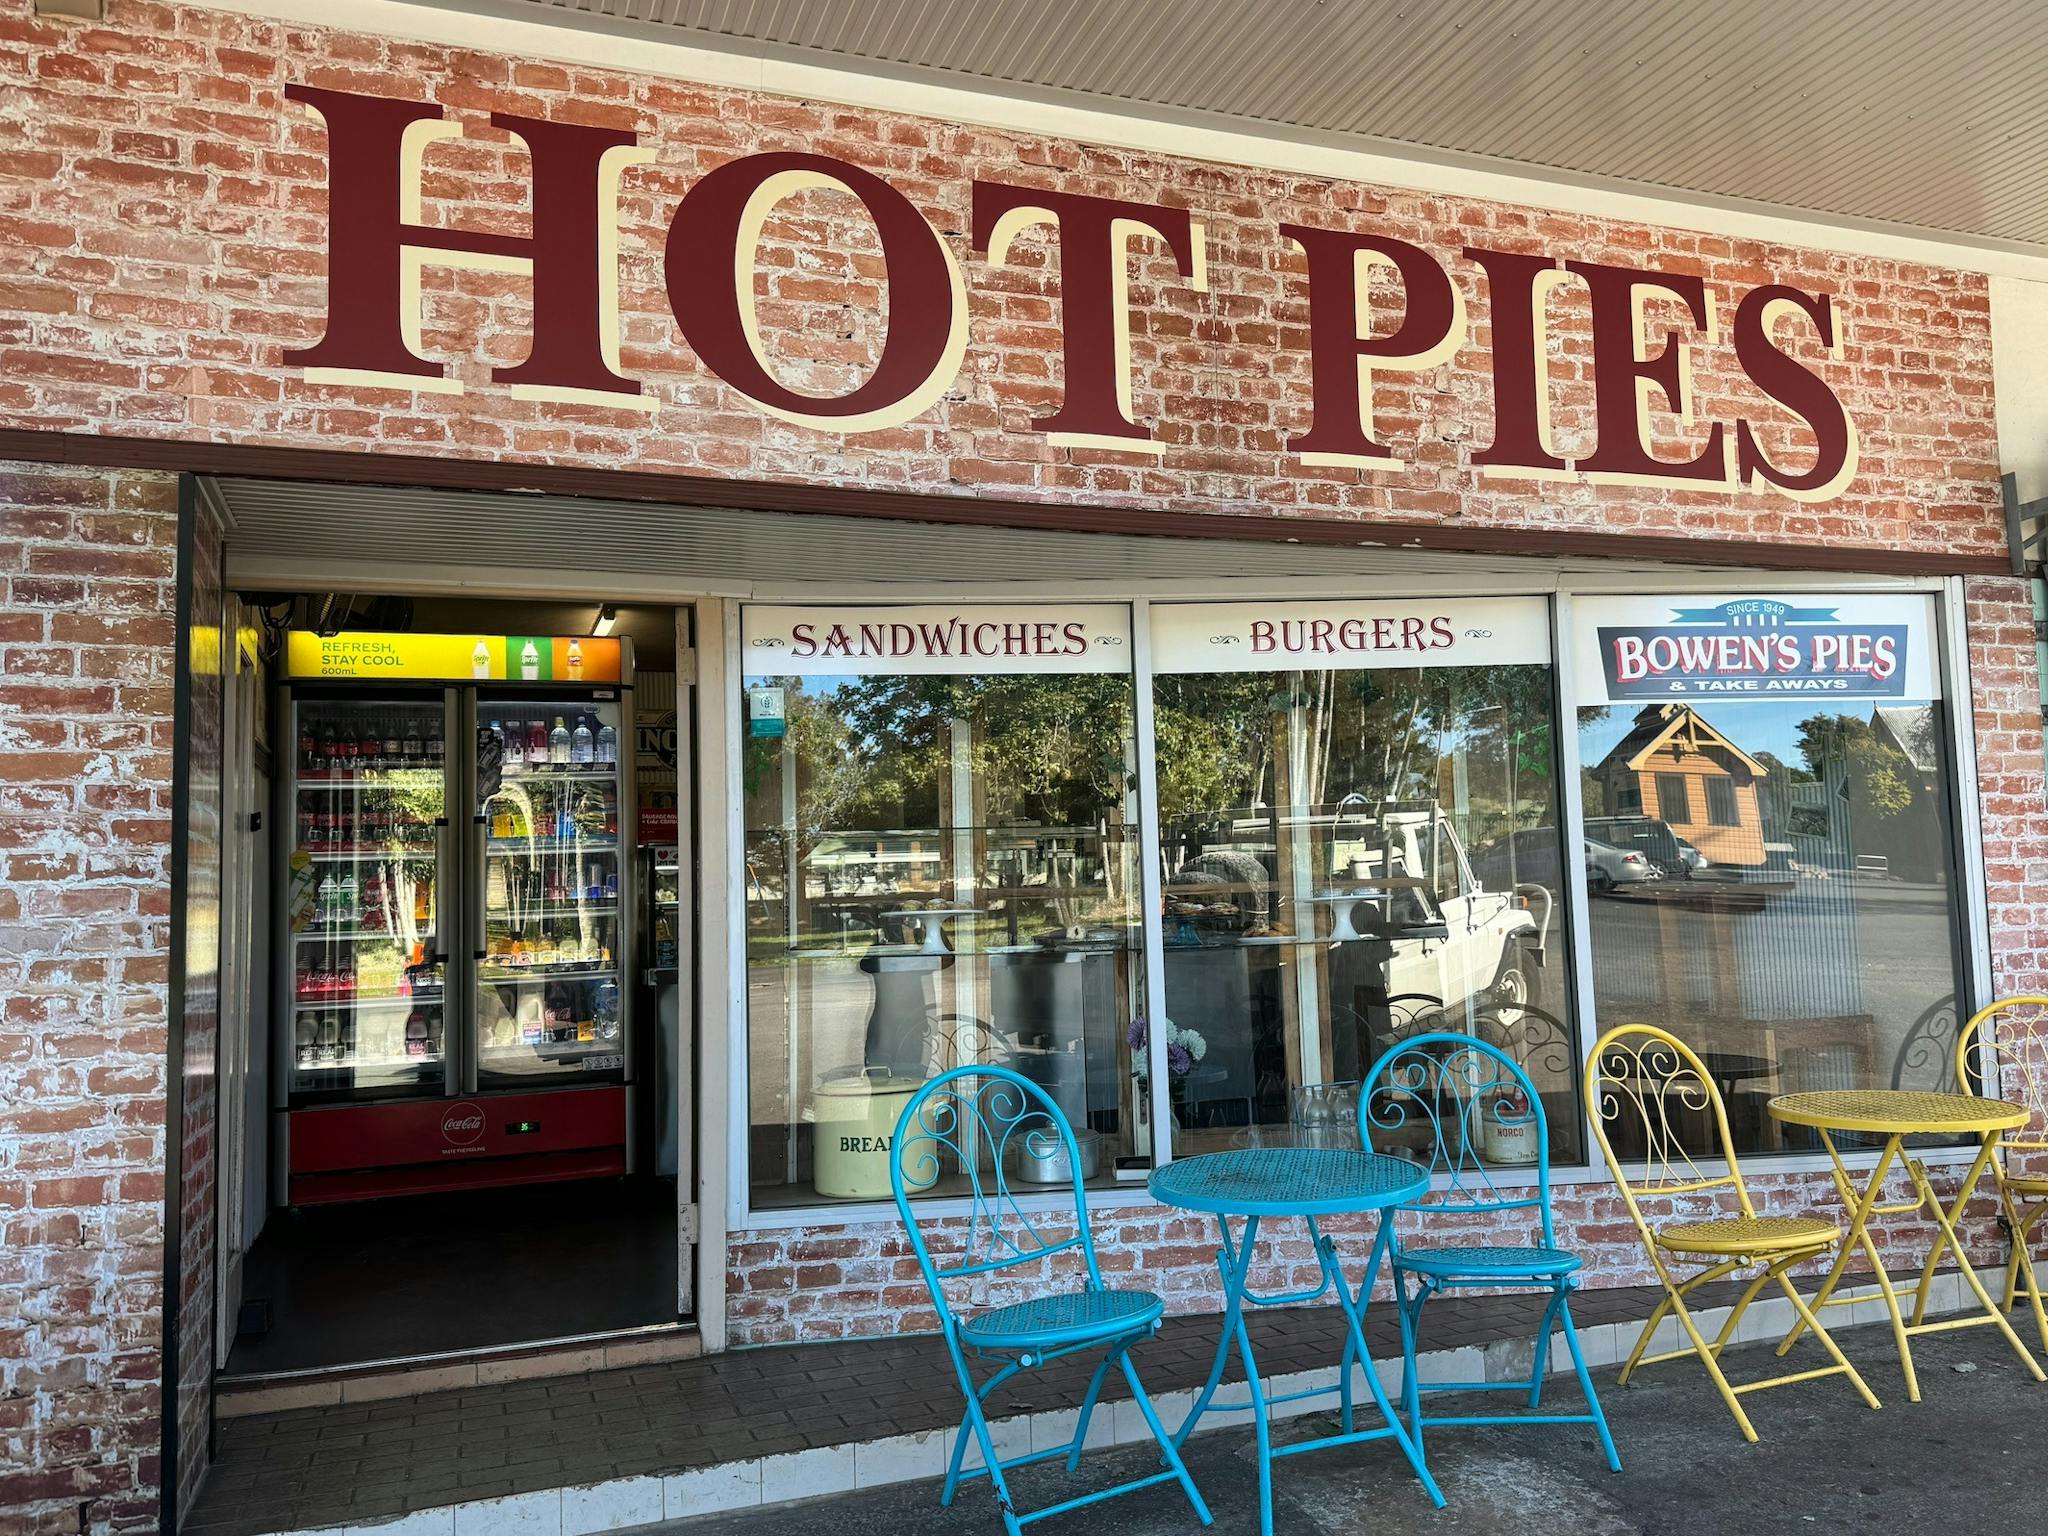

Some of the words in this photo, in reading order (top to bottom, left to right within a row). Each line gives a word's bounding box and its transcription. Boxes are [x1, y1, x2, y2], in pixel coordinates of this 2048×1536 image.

[283, 82, 1207, 455] HOT
[1279, 222, 1858, 502] PIES
[1726, 602, 1760, 616] SINCE
[1763, 602, 1785, 616] 1949
[790, 616, 1089, 657] SANDWICHES
[1249, 617, 1456, 655] BURGERS
[322, 642, 396, 654] REFRESH,
[321, 655, 358, 665] STAY
[363, 655, 404, 666] COOL
[1614, 632, 1801, 683] BOWEN'S
[1811, 634, 1898, 681] PIES
[321, 667, 357, 675] 600mL
[1669, 681, 1686, 692] &
[1694, 680, 1759, 691] TAKE
[1765, 679, 1849, 691] AWAYS
[1497, 1127, 1524, 1137] NORCO
